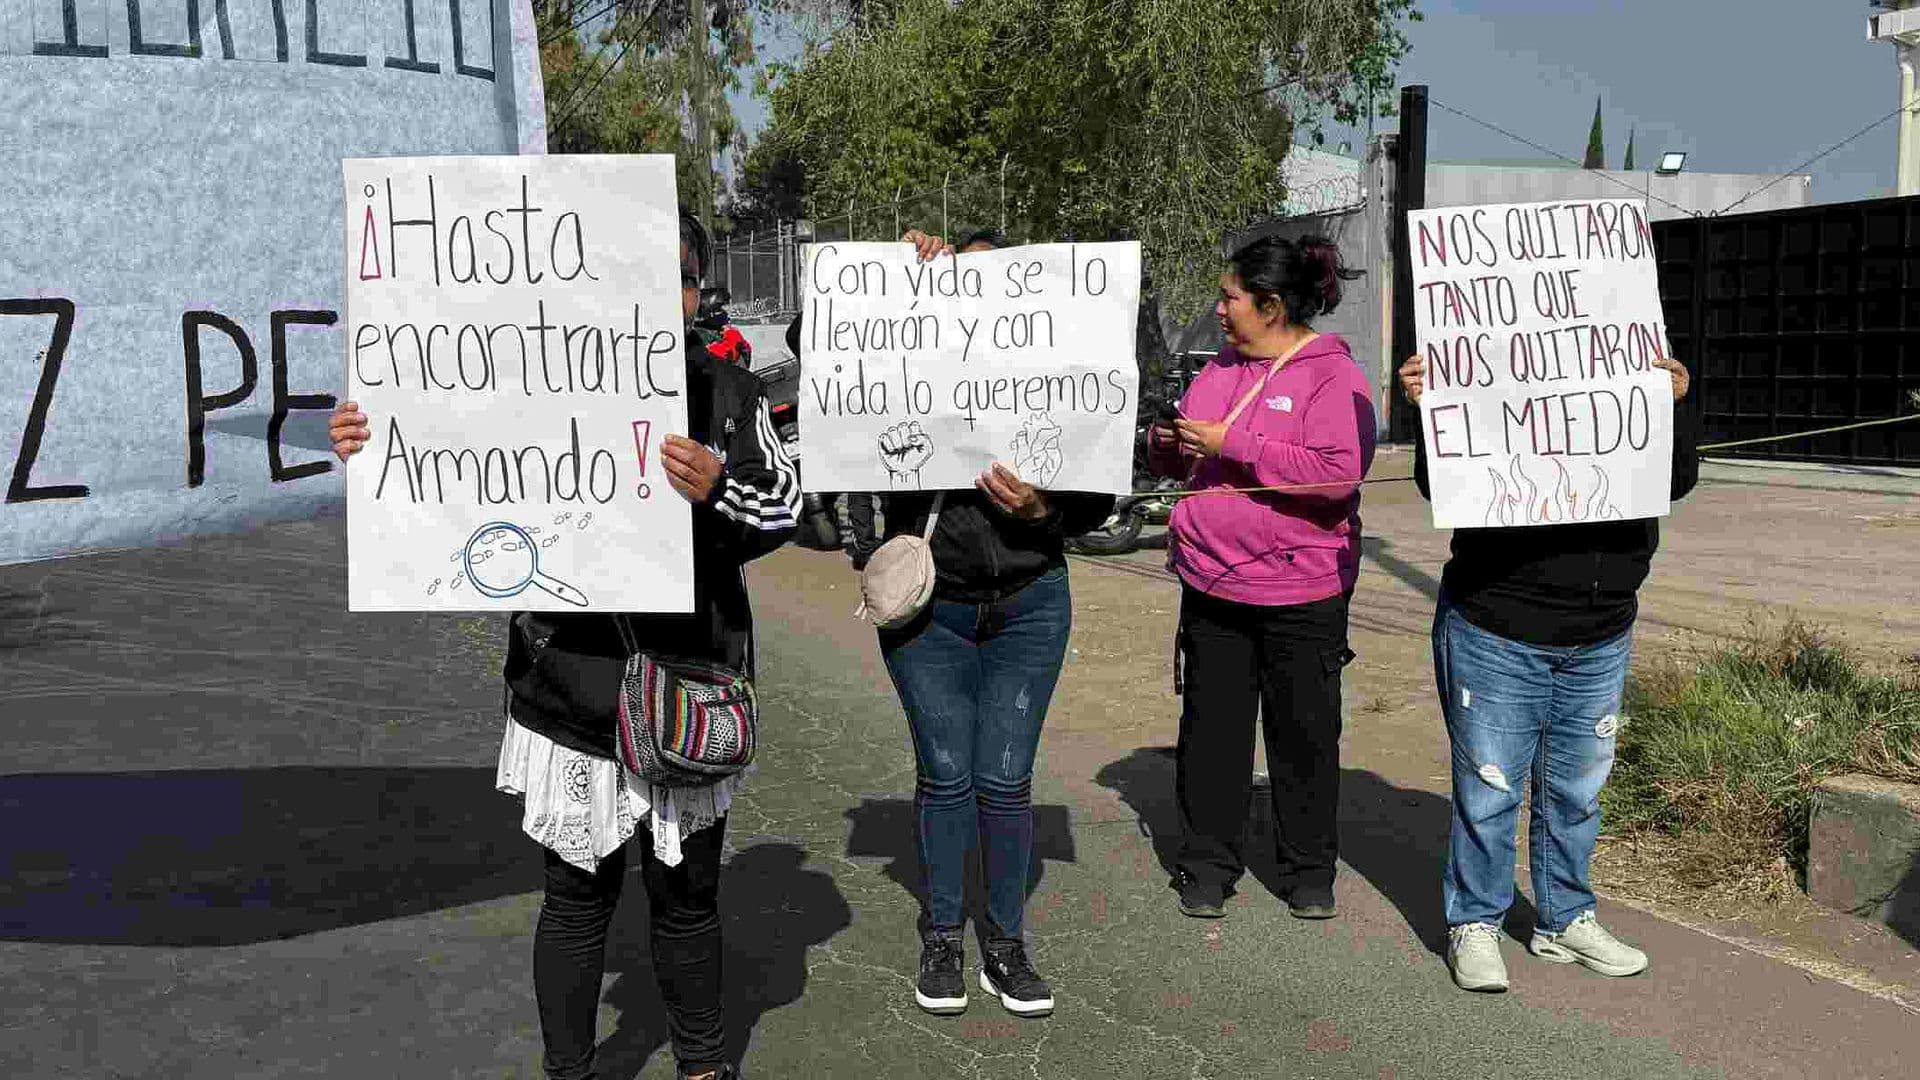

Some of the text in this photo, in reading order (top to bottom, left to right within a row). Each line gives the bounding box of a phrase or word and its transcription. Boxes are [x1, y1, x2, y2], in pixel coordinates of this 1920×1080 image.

[1419, 202, 1654, 267] NOS QUITARON
[813, 244, 1107, 298] Con vida se lo
[1419, 269, 1588, 328] TANTO QUE
[355, 300, 680, 400] encontrarte
[811, 298, 1054, 362] llevarón y con
[1427, 322, 1664, 390] NOS QUITARON
[811, 356, 1127, 432] vida lo queremos
[1430, 386, 1650, 458] EL MIEDO
[375, 416, 617, 505] Armando
